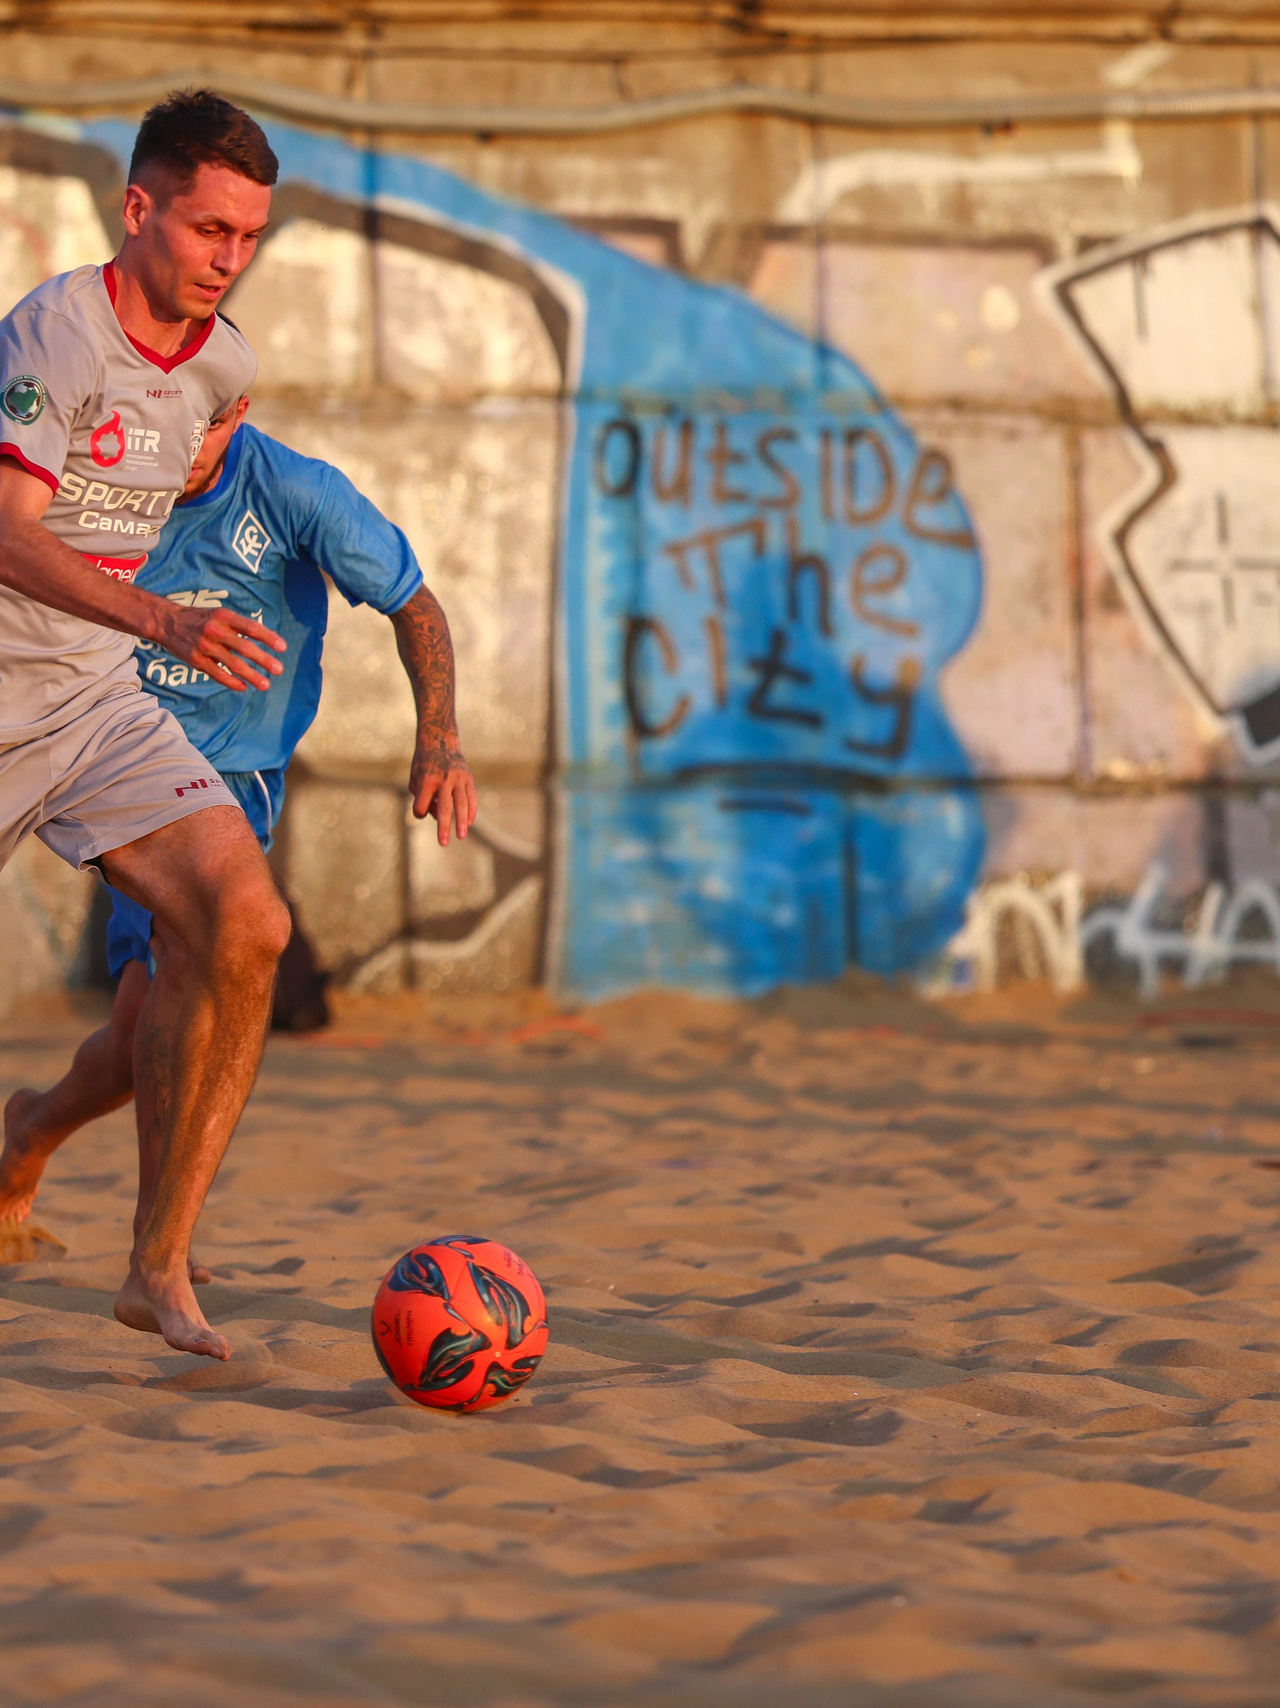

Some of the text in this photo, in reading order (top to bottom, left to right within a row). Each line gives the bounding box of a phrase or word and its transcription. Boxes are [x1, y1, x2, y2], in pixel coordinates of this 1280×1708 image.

[57, 472, 168, 516] SPORT
[663, 514, 919, 639] The
[146, 657, 233, 687] бан
